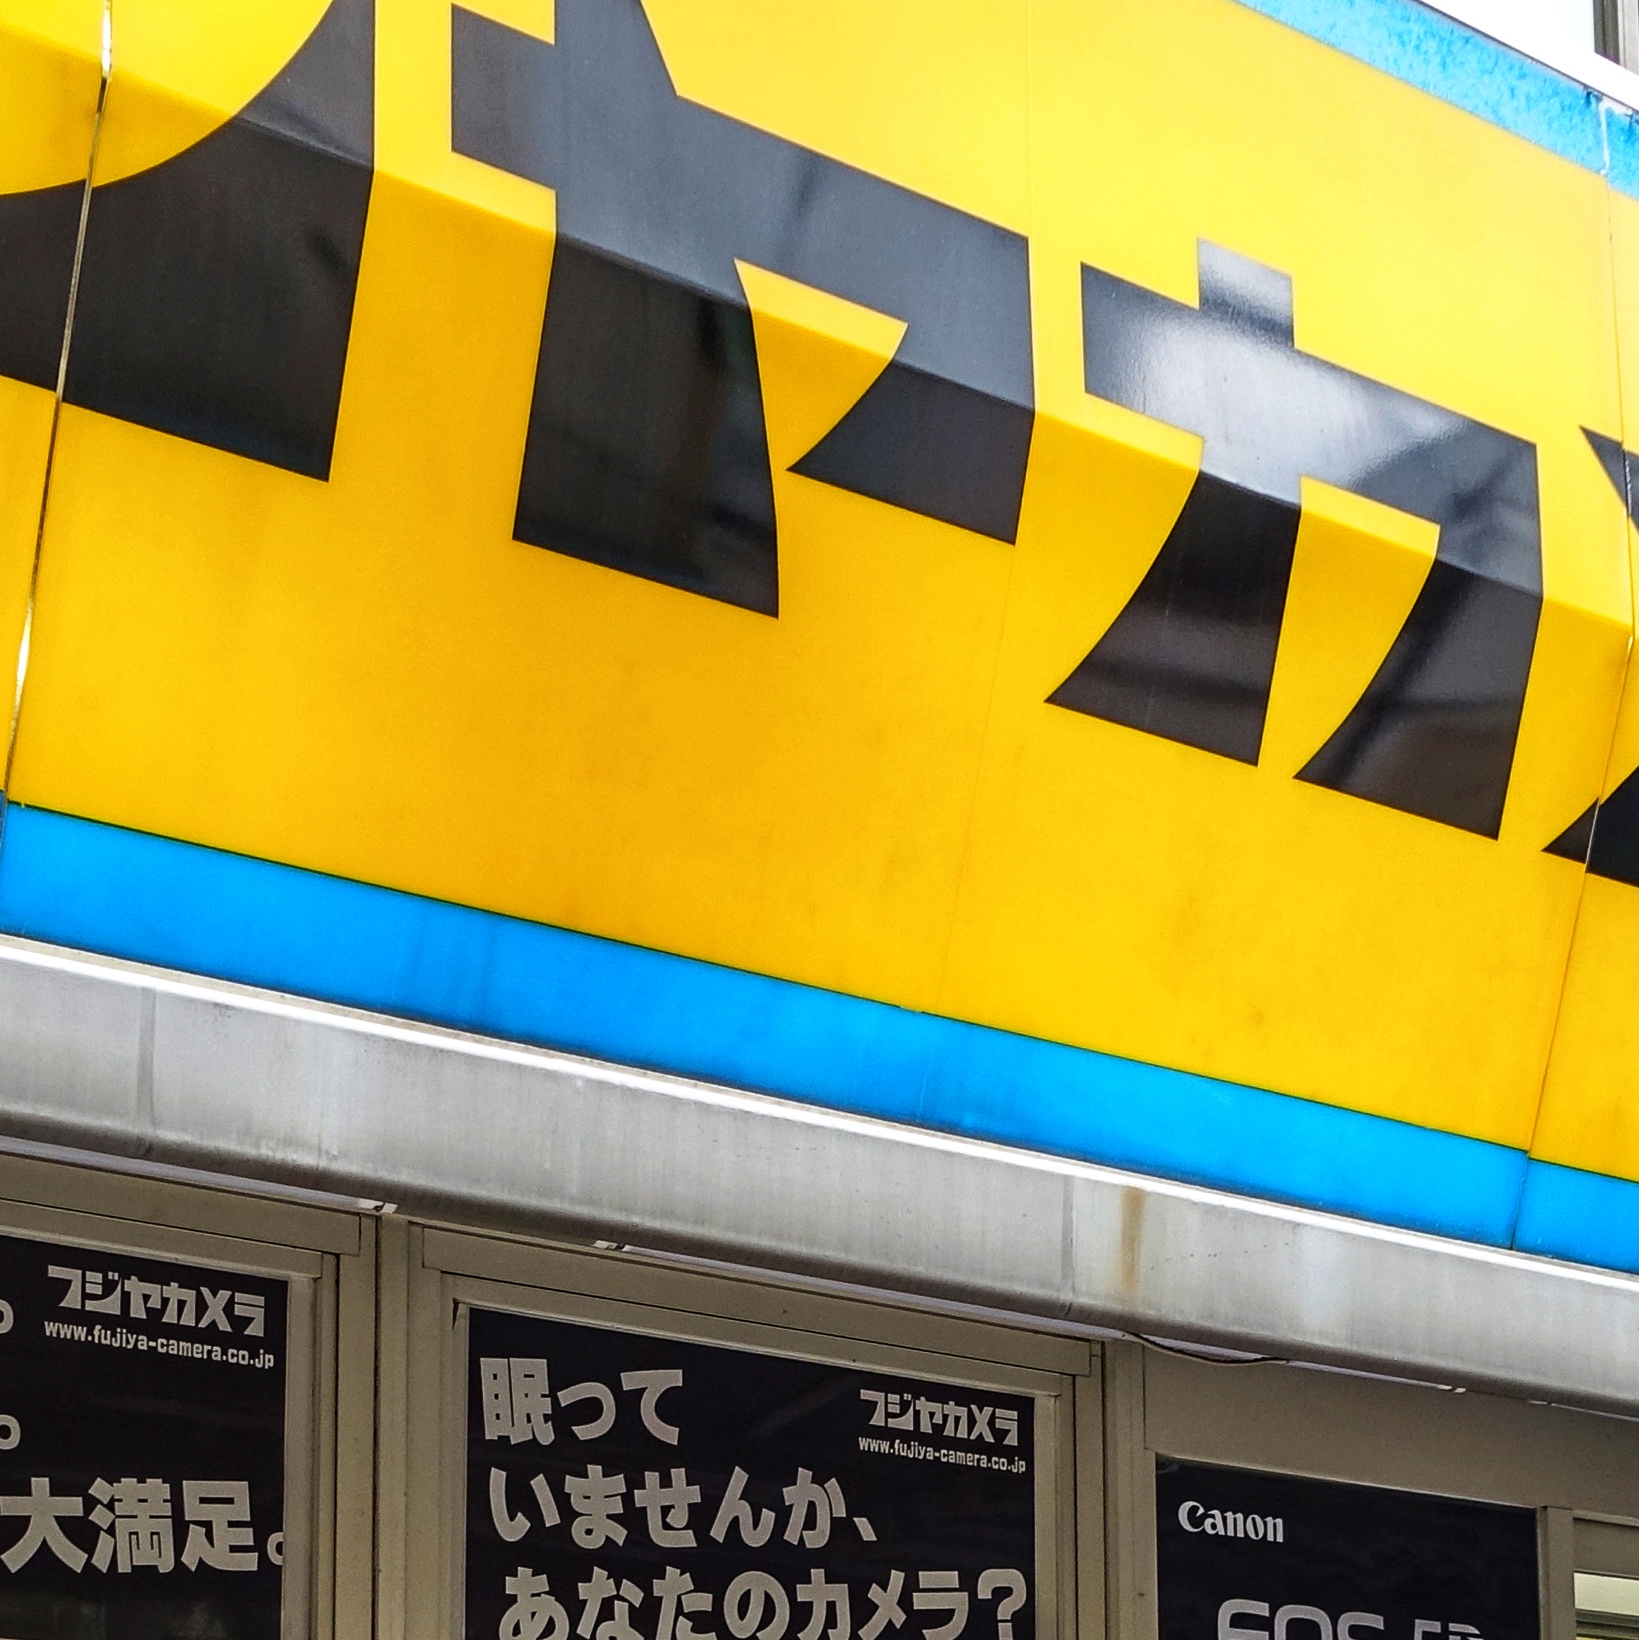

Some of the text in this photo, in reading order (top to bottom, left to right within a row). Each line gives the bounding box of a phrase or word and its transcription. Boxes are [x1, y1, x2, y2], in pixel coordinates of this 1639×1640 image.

[46, 1264, 267, 1338] フジヤカメラ
[44, 1317, 276, 1370] www.fujiya-camera.co.jp
[480, 1357, 684, 1446] 眠って
[860, 1389, 1020, 1446] フジヤカメラ
[858, 1436, 1027, 1476] www.fujiya-camera.co.jp
[490, 1465, 878, 1549] いませんか、
[1178, 1501, 1284, 1543] Canon
